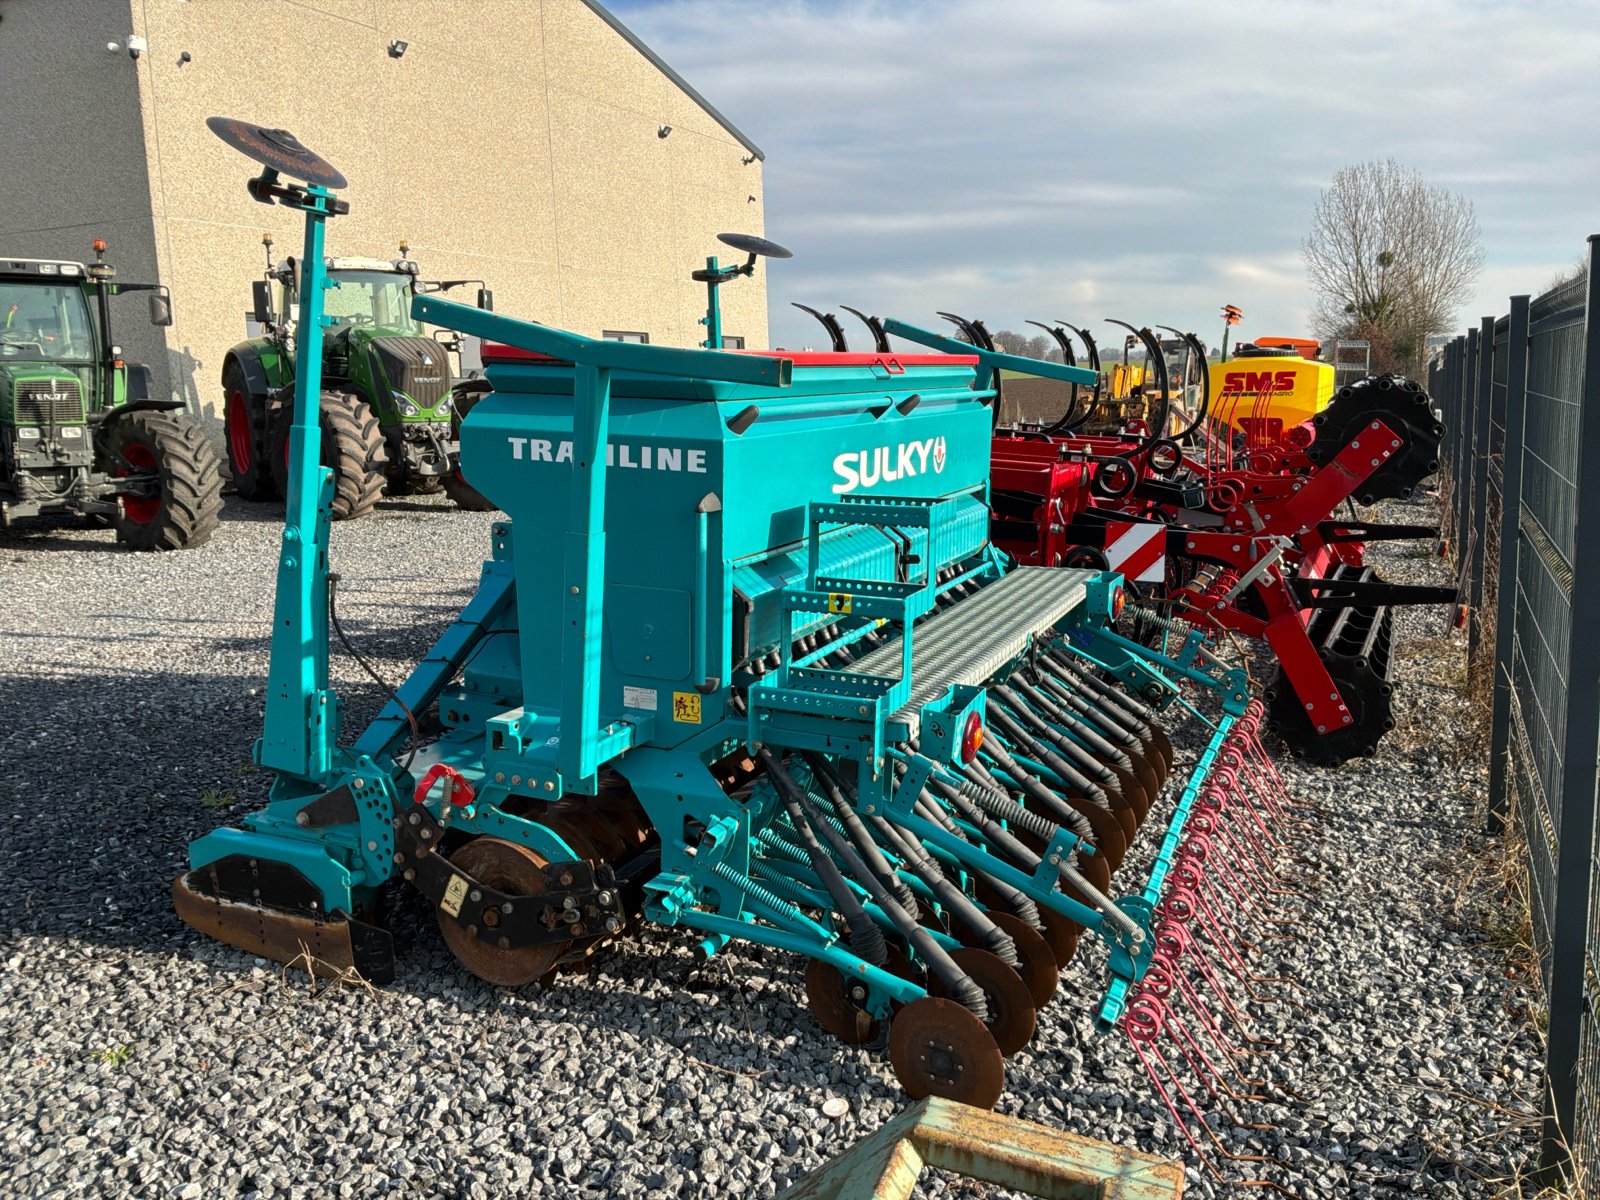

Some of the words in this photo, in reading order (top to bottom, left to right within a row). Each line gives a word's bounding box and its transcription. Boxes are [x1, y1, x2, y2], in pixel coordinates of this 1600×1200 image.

[1223, 371, 1297, 392] SMS
[28, 393, 68, 401] FENDT
[832, 438, 934, 494] SULKY
